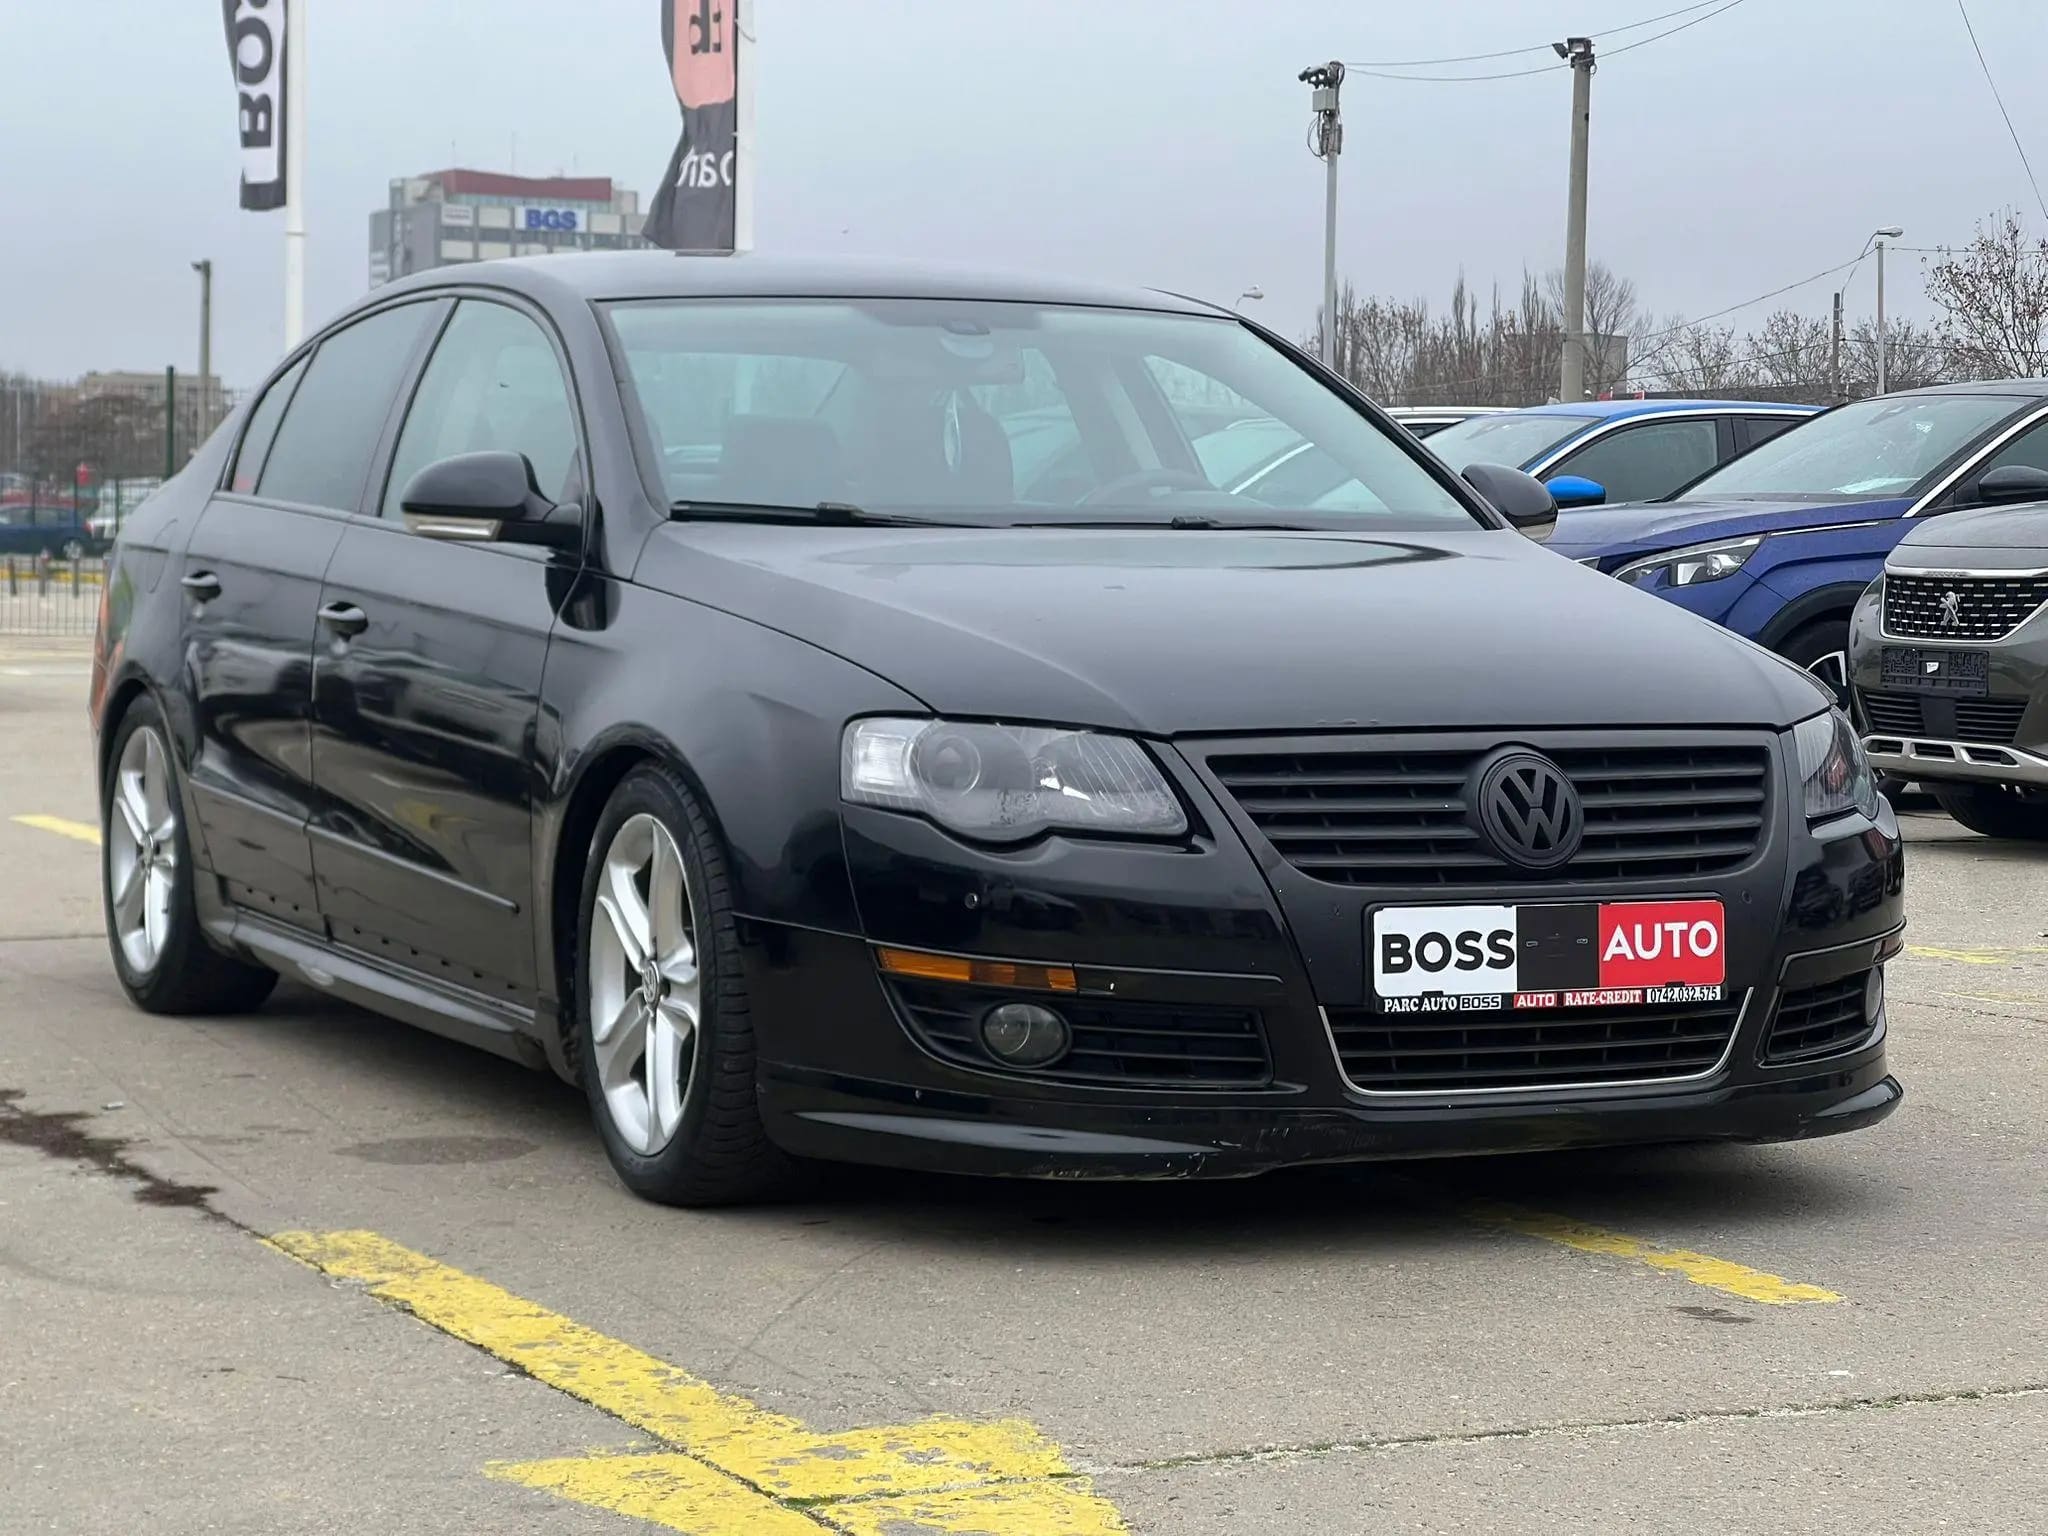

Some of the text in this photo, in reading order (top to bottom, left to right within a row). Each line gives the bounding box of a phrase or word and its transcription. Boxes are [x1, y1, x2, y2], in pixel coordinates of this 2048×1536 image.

[526, 209, 577, 230] BGS
[1485, 757, 1577, 861] VW
[1381, 920, 1717, 974] BOSS AUTO
[1384, 998, 1419, 1012] PARC
[1421, 996, 1457, 1011] AUTO
[1461, 996, 1501, 1010] BOSS
[1516, 993, 1556, 1008] AUTO
